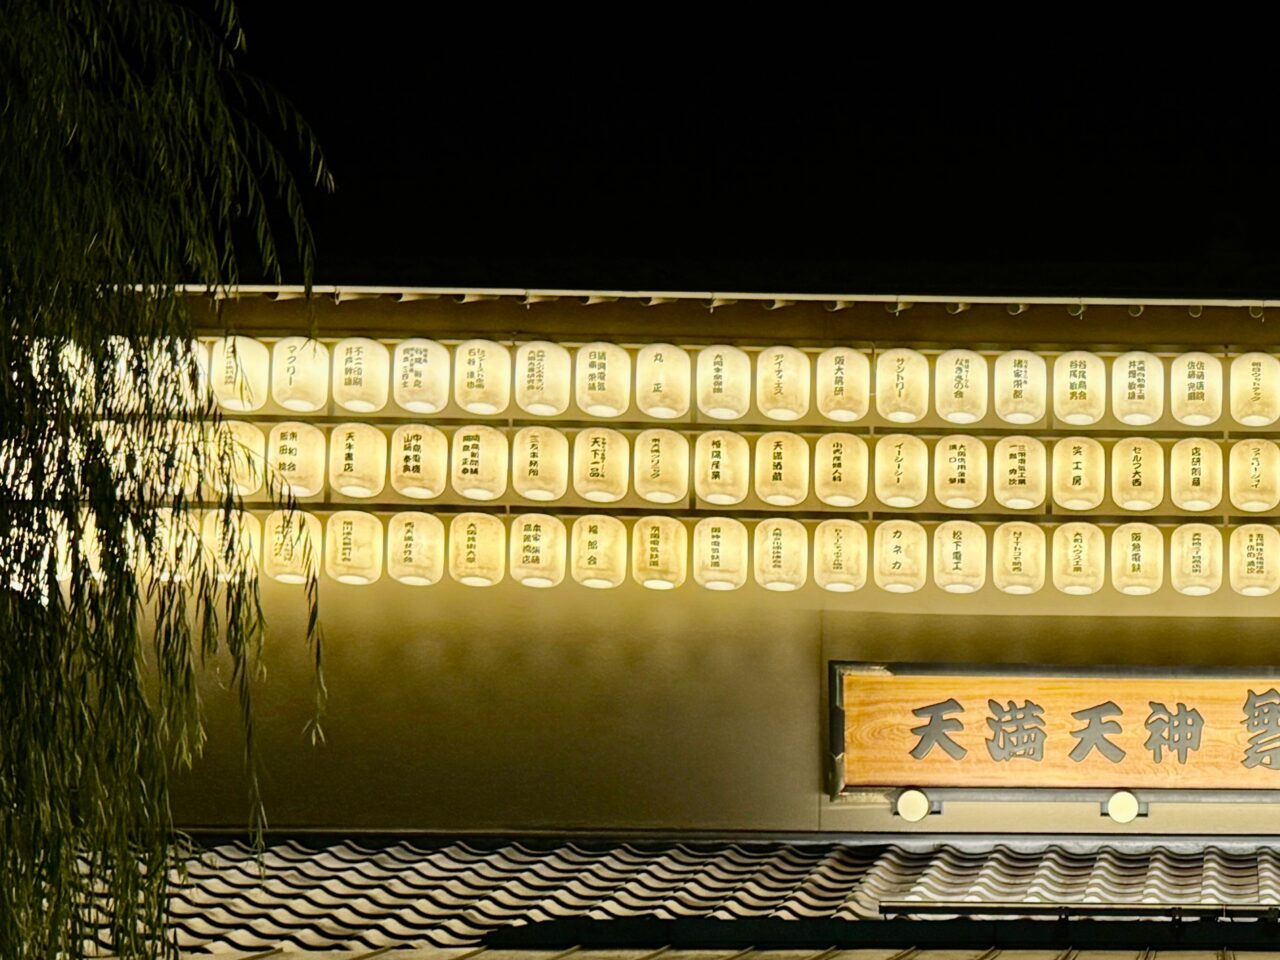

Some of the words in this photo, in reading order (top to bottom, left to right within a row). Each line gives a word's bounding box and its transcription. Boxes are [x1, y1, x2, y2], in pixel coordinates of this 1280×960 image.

[653, 353, 664, 393] 丸正
[895, 358, 905, 398] サントリー
[344, 432, 354, 473] 天牛書店
[590, 437, 600, 478] 天下一品
[894, 443, 903, 484] イーシーシー
[1072, 446, 1083, 487] 笑工房
[1132, 447, 1142, 487] セルフ大西
[892, 530, 902, 571] カネカ
[952, 530, 963, 572] 松下電工
[1132, 532, 1142, 573] 阪急電鉄
